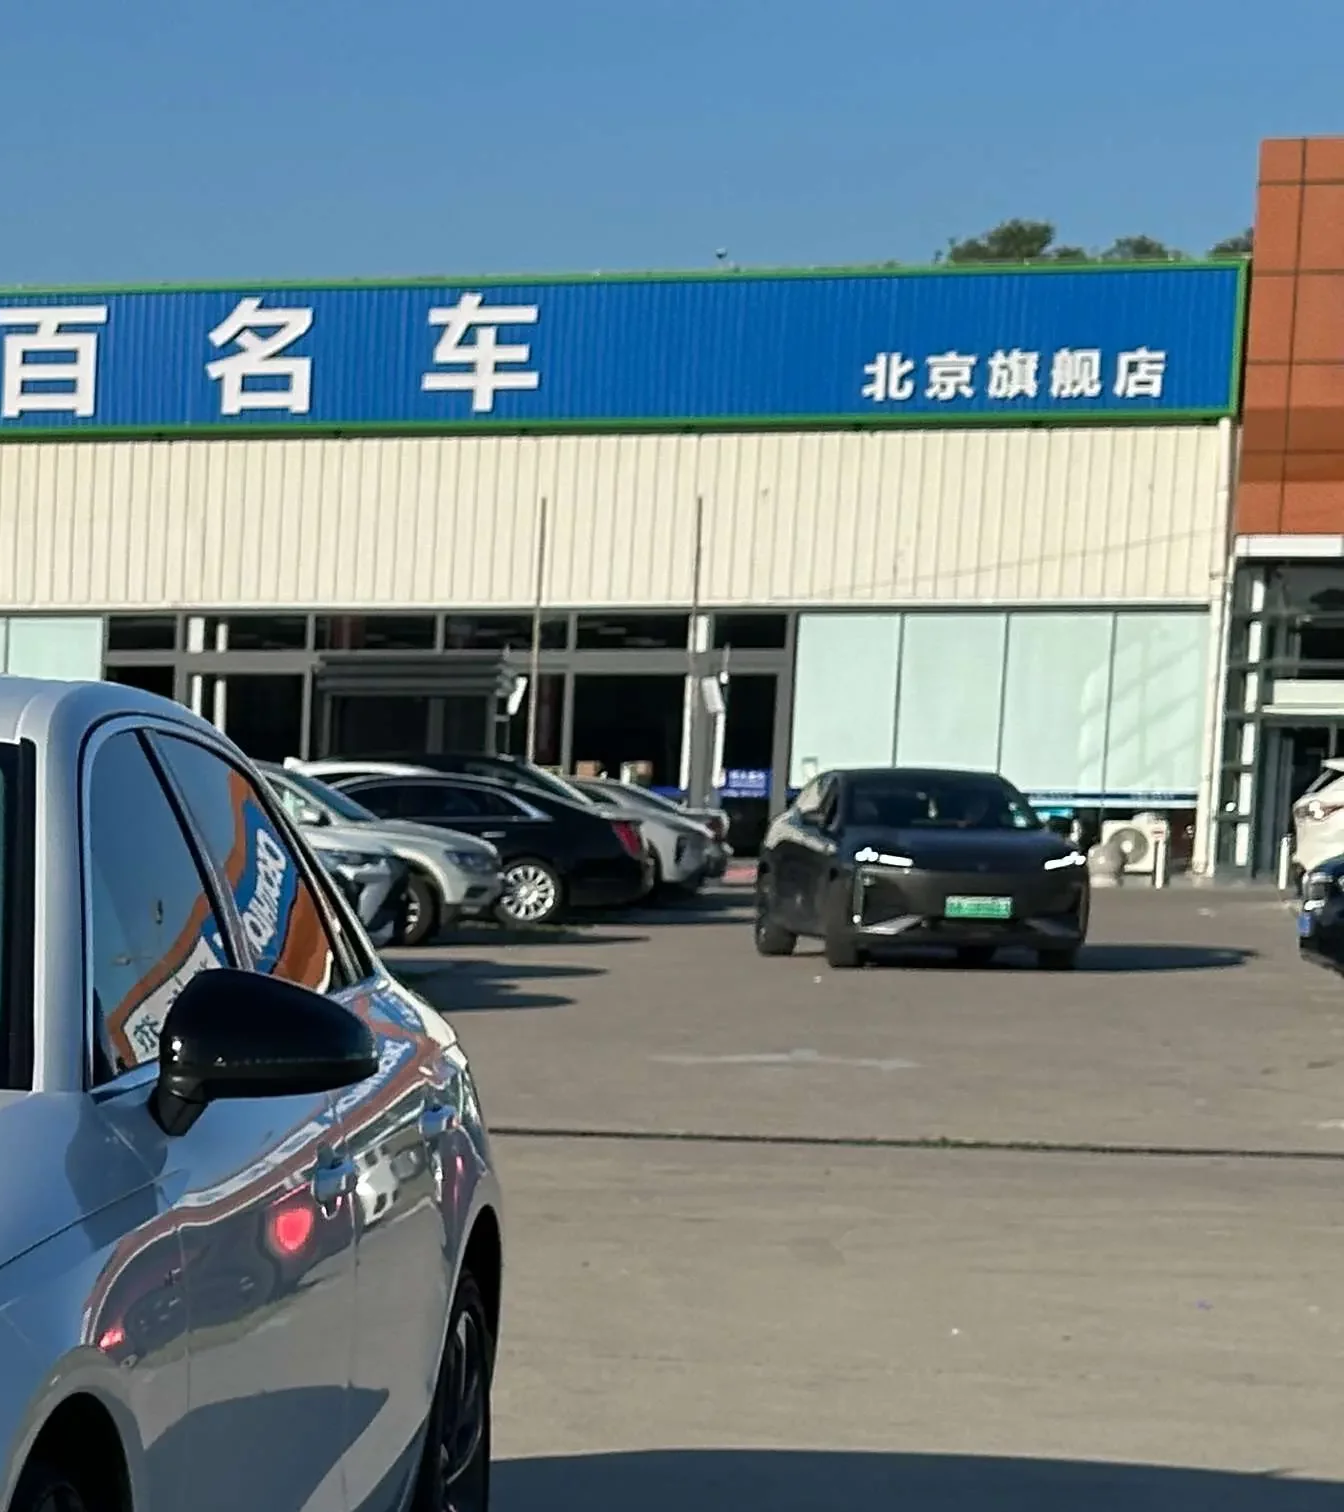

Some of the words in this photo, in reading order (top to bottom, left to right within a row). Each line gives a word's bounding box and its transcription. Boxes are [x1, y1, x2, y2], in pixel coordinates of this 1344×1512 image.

[862, 346, 1166, 402] 北京旗舰店
